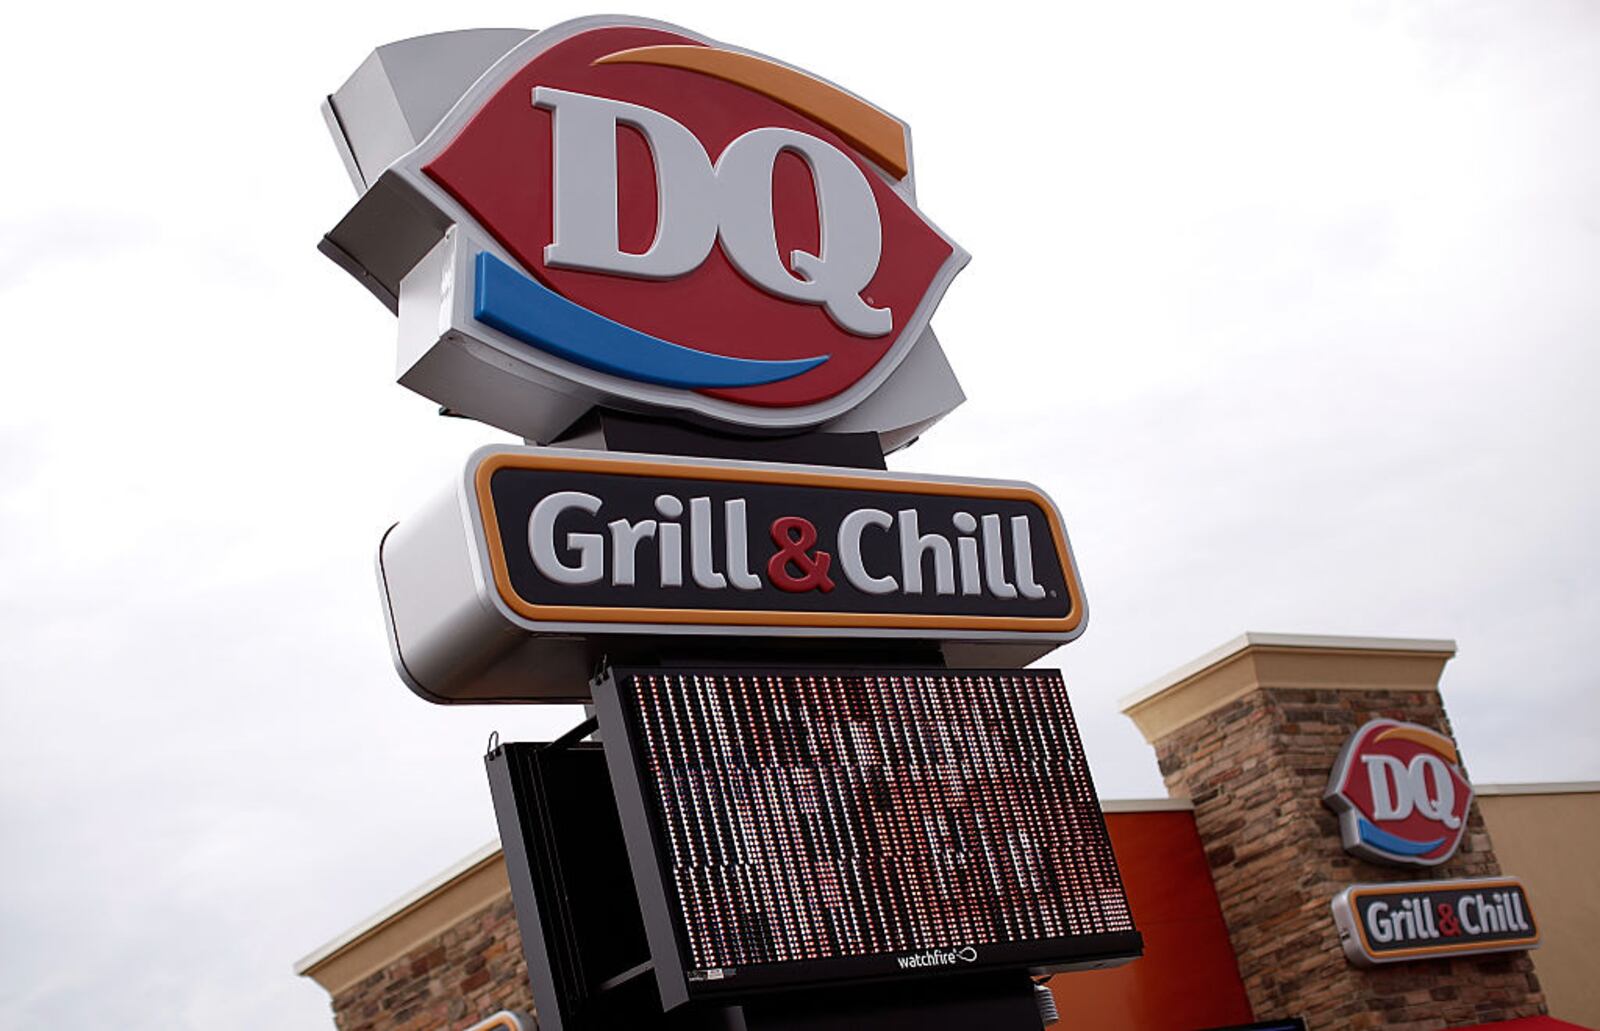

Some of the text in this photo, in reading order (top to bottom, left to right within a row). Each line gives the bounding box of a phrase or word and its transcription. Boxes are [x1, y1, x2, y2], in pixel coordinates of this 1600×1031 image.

[532, 86, 893, 337] DQ
[1361, 753, 1461, 829] DQ
[898, 950, 956, 969] watchfire
